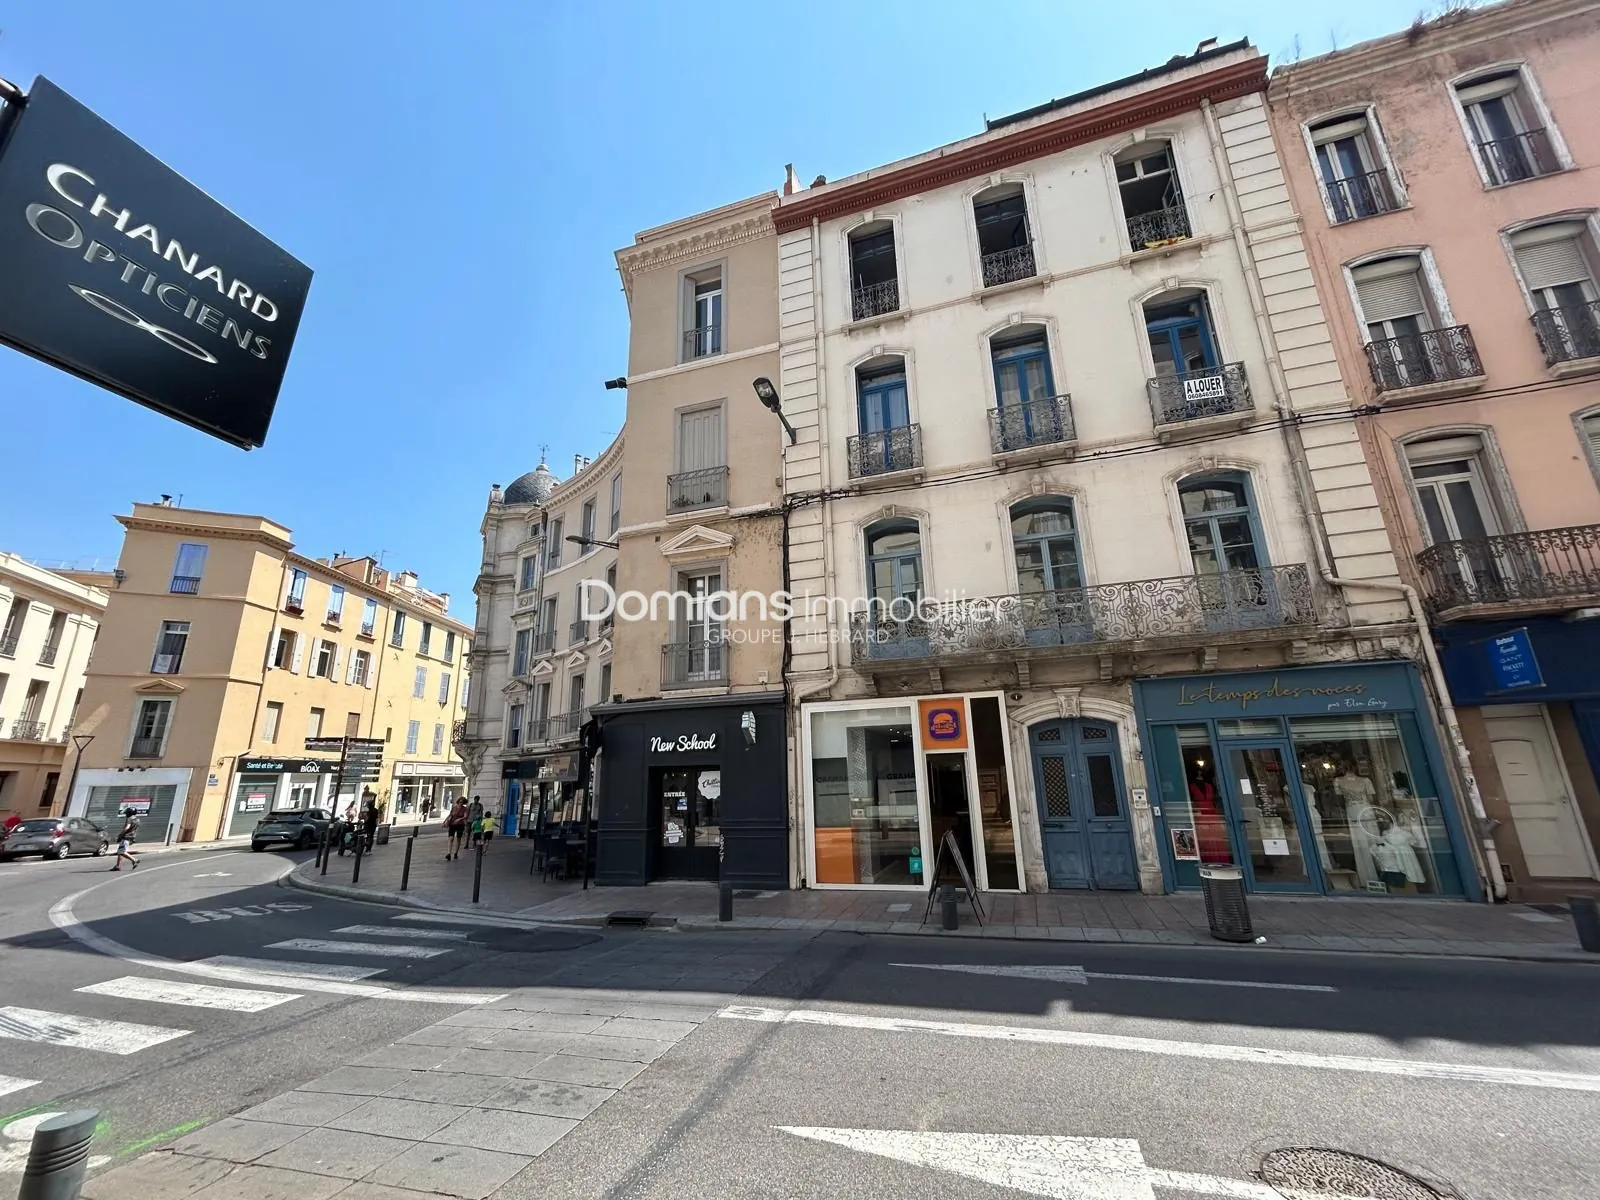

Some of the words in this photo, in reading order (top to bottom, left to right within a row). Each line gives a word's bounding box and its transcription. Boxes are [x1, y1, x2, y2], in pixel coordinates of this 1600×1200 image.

[46, 161, 280, 323] CHANARD
[25, 202, 273, 360] OPTICIENS
[1187, 382, 1193, 394] A
[1194, 378, 1222, 393] LOUER
[1200, 682, 1260, 710] temps
[1265, 676, 1302, 698] des
[1304, 683, 1367, 696] noces
[650, 736, 676, 753] New
[676, 733, 716, 752] School
